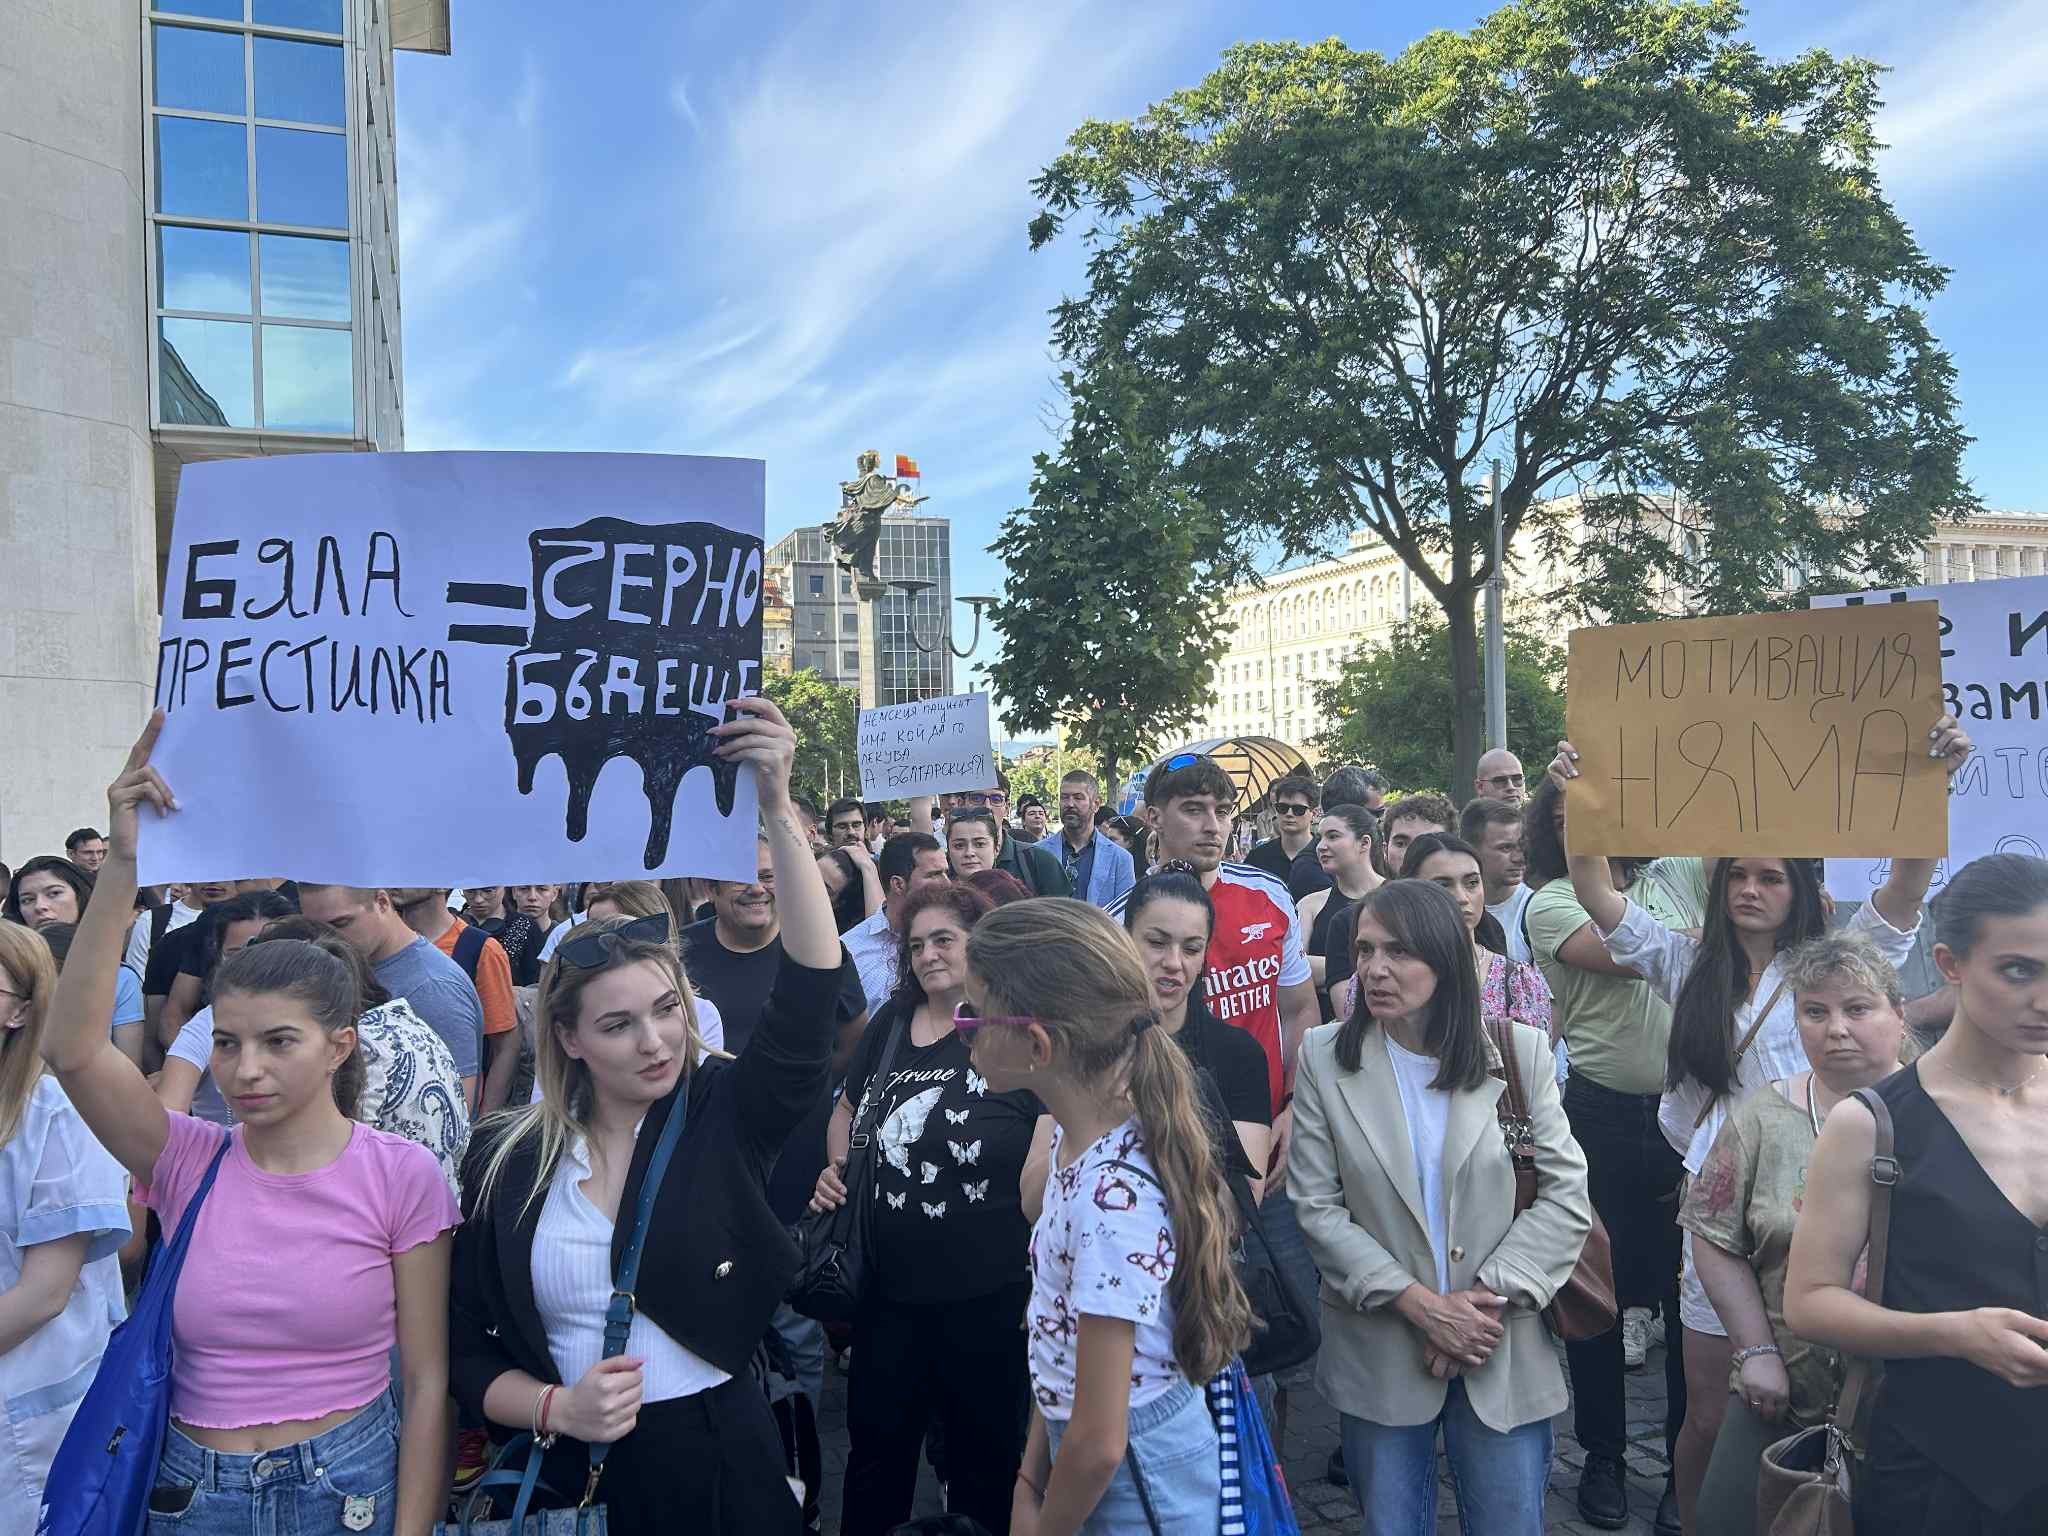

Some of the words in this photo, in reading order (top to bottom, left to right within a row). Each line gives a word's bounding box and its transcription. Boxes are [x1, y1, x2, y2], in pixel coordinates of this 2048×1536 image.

[181, 531, 415, 620] БЯЛА
[537, 538, 761, 629] ЧЕРНО
[153, 635, 456, 724] ПРЕСТИЛКА
[514, 650, 760, 727] БЪДЕЩЕ
[864, 705, 917, 728] НЕМСКИЯ
[923, 698, 977, 723] ПАЦИЕНТ
[1615, 632, 1918, 723] МОТИВАЦИЯ
[861, 731, 887, 749] ИМА
[897, 723, 924, 744] КОЙ
[928, 723, 945, 744] ДА
[952, 722, 965, 735] ГО
[861, 748, 910, 766] ЛЕКУВА
[1610, 708, 1910, 833] НЯМА
[864, 768, 876, 789] А
[1219, 984, 1271, 1021] BETTER
